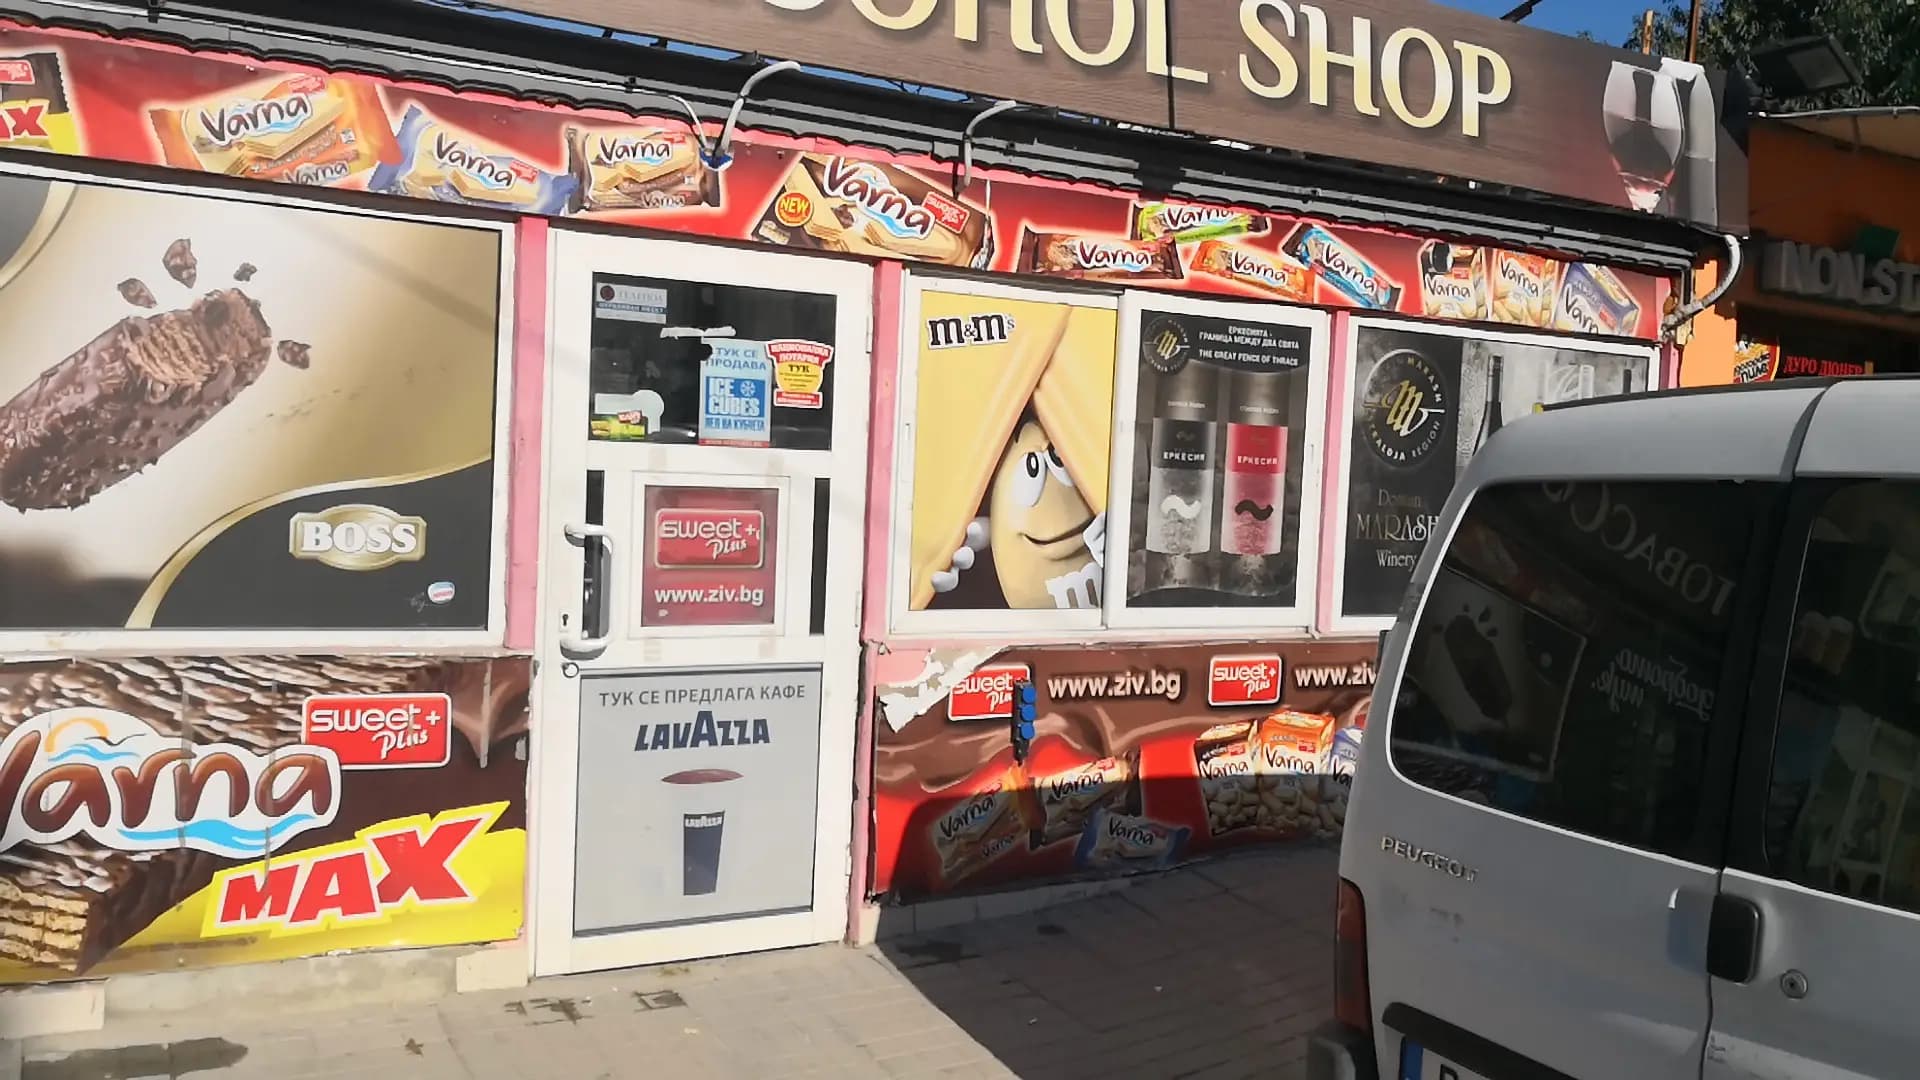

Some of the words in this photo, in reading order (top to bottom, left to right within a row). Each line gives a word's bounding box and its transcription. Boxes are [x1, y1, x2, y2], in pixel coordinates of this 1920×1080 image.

[1239, 0, 1512, 137] SHOP
[200, 94, 309, 142] Varna
[436, 132, 512, 187] Varna
[599, 136, 670, 161] Varna
[780, 197, 809, 211] NEW
[828, 155, 931, 235] Varna
[1077, 239, 1152, 267] Varna
[1233, 251, 1286, 283] Varna
[1324, 243, 1375, 294] Varna
[1501, 255, 1539, 297] Varna
[1427, 279, 1471, 298] Varna
[705, 357, 766, 370] ПРОДАВА
[716, 347, 739, 357] ТУК
[743, 349, 757, 358] СЕ
[1199, 348, 1213, 359] THE
[1214, 350, 1237, 361] GREAT
[1261, 354, 1271, 364] OF
[1272, 355, 1299, 367] THRACE
[788, 364, 811, 373] ТУК
[708, 377, 735, 396] ICE
[1163, 451, 1206, 462] ЕРКЕСИЯ
[1237, 455, 1279, 466] ЕРКЕСИЯ
[301, 521, 417, 554] BOSS
[1377, 550, 1417, 572] Winery
[654, 585, 765, 606] www.ziv.bg
[600, 691, 633, 707] ТУК
[639, 690, 660, 705] СЕ
[665, 687, 755, 705] ПРЕДЛАГА
[760, 684, 806, 700] КАФЕ
[1047, 669, 1182, 701] www.ziv.bg
[1200, 759, 1249, 781] Varna
[1265, 747, 1315, 775] Varna
[1050, 771, 1104, 799] Varna
[940, 796, 994, 838] Varna
[1109, 816, 1155, 845] Varna
[219, 817, 484, 924] MAX
[1381, 836, 1479, 883] PEUGEOT
